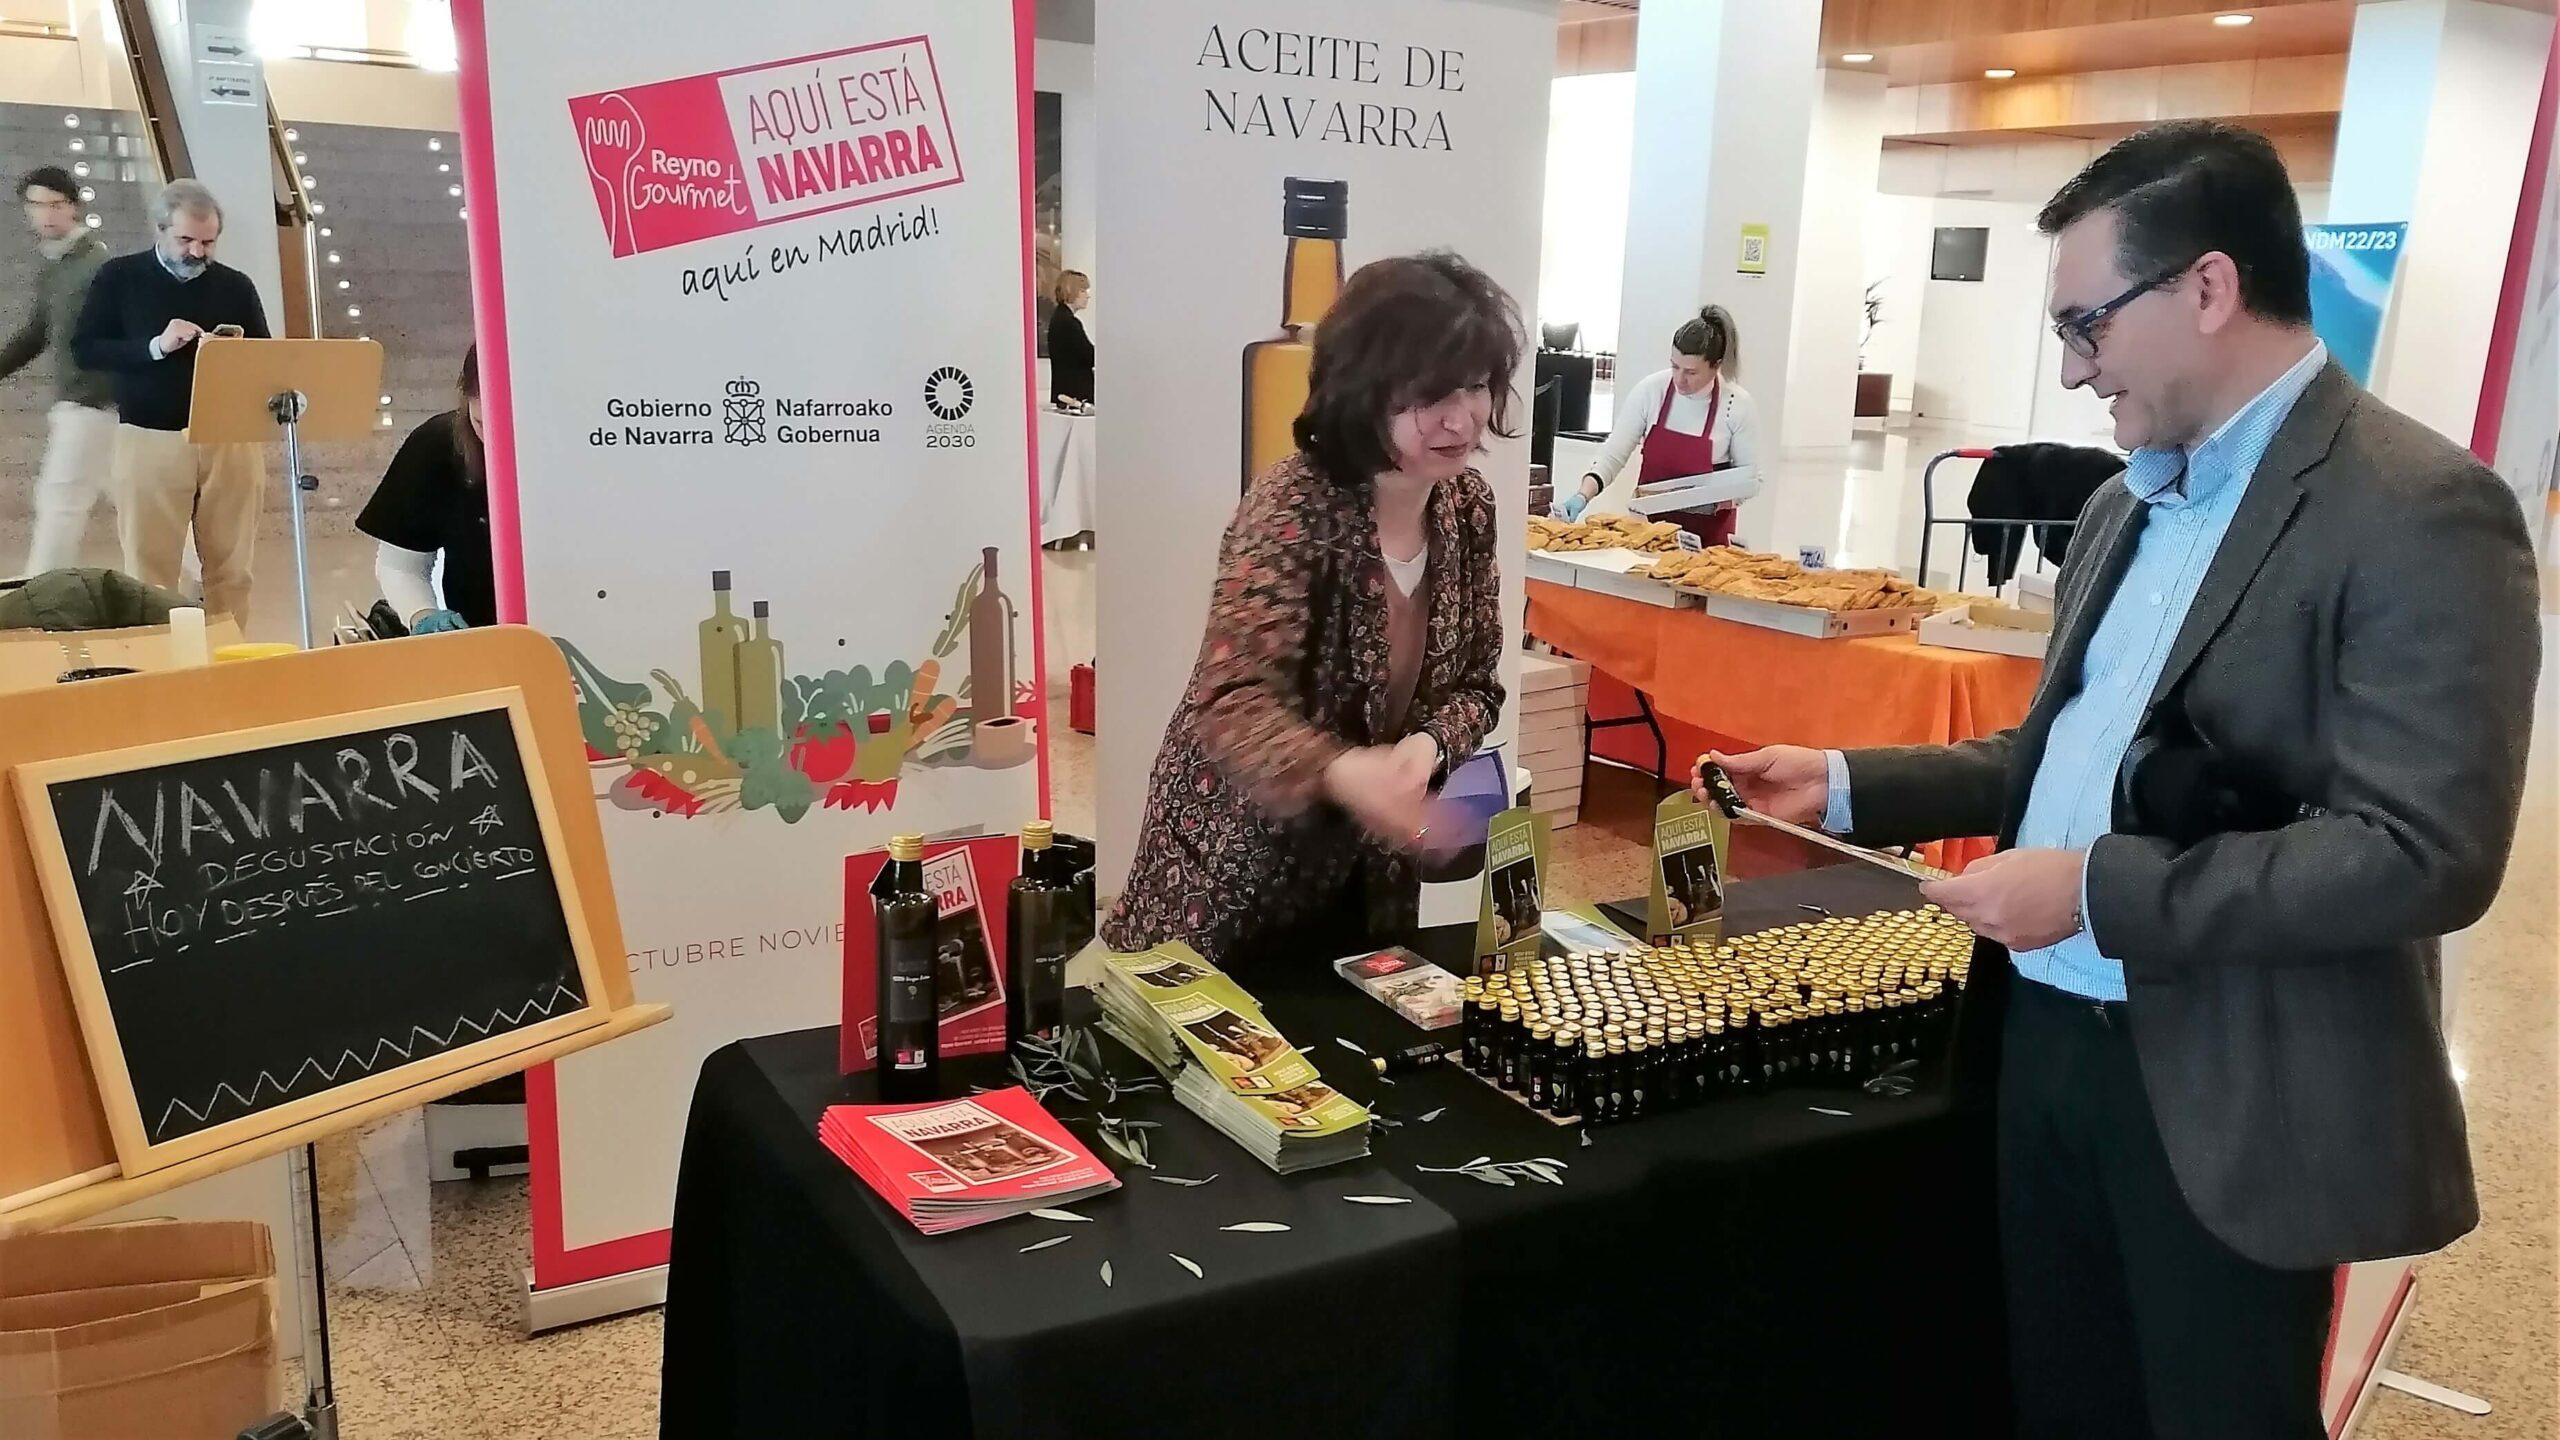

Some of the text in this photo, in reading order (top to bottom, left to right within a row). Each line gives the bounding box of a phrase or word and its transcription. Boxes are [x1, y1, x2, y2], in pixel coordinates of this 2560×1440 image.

[1196, 24, 1465, 92] ACEITE DE
[749, 52, 926, 145] AQUÍ ESTÁ
[1204, 88, 1455, 151] NAVARRA
[651, 149, 721, 181] Reyno
[757, 124, 944, 204] NAVARRA
[630, 163, 748, 215] Gourmet
[682, 204, 940, 302] aquí en Madrid!
[607, 399, 712, 418] Gobierno
[776, 398, 893, 417] Nafarroako
[589, 427, 713, 446] de Navarra
[777, 425, 880, 444] Gobernua
[926, 424, 975, 434] AGENDA
[926, 436, 976, 448] 2030
[88, 731, 500, 876] NAVARRA
[1661, 829, 1708, 851] NAVARRA
[124, 899, 208, 954] HOY
[902, 1116, 990, 1138] NAVARRA
